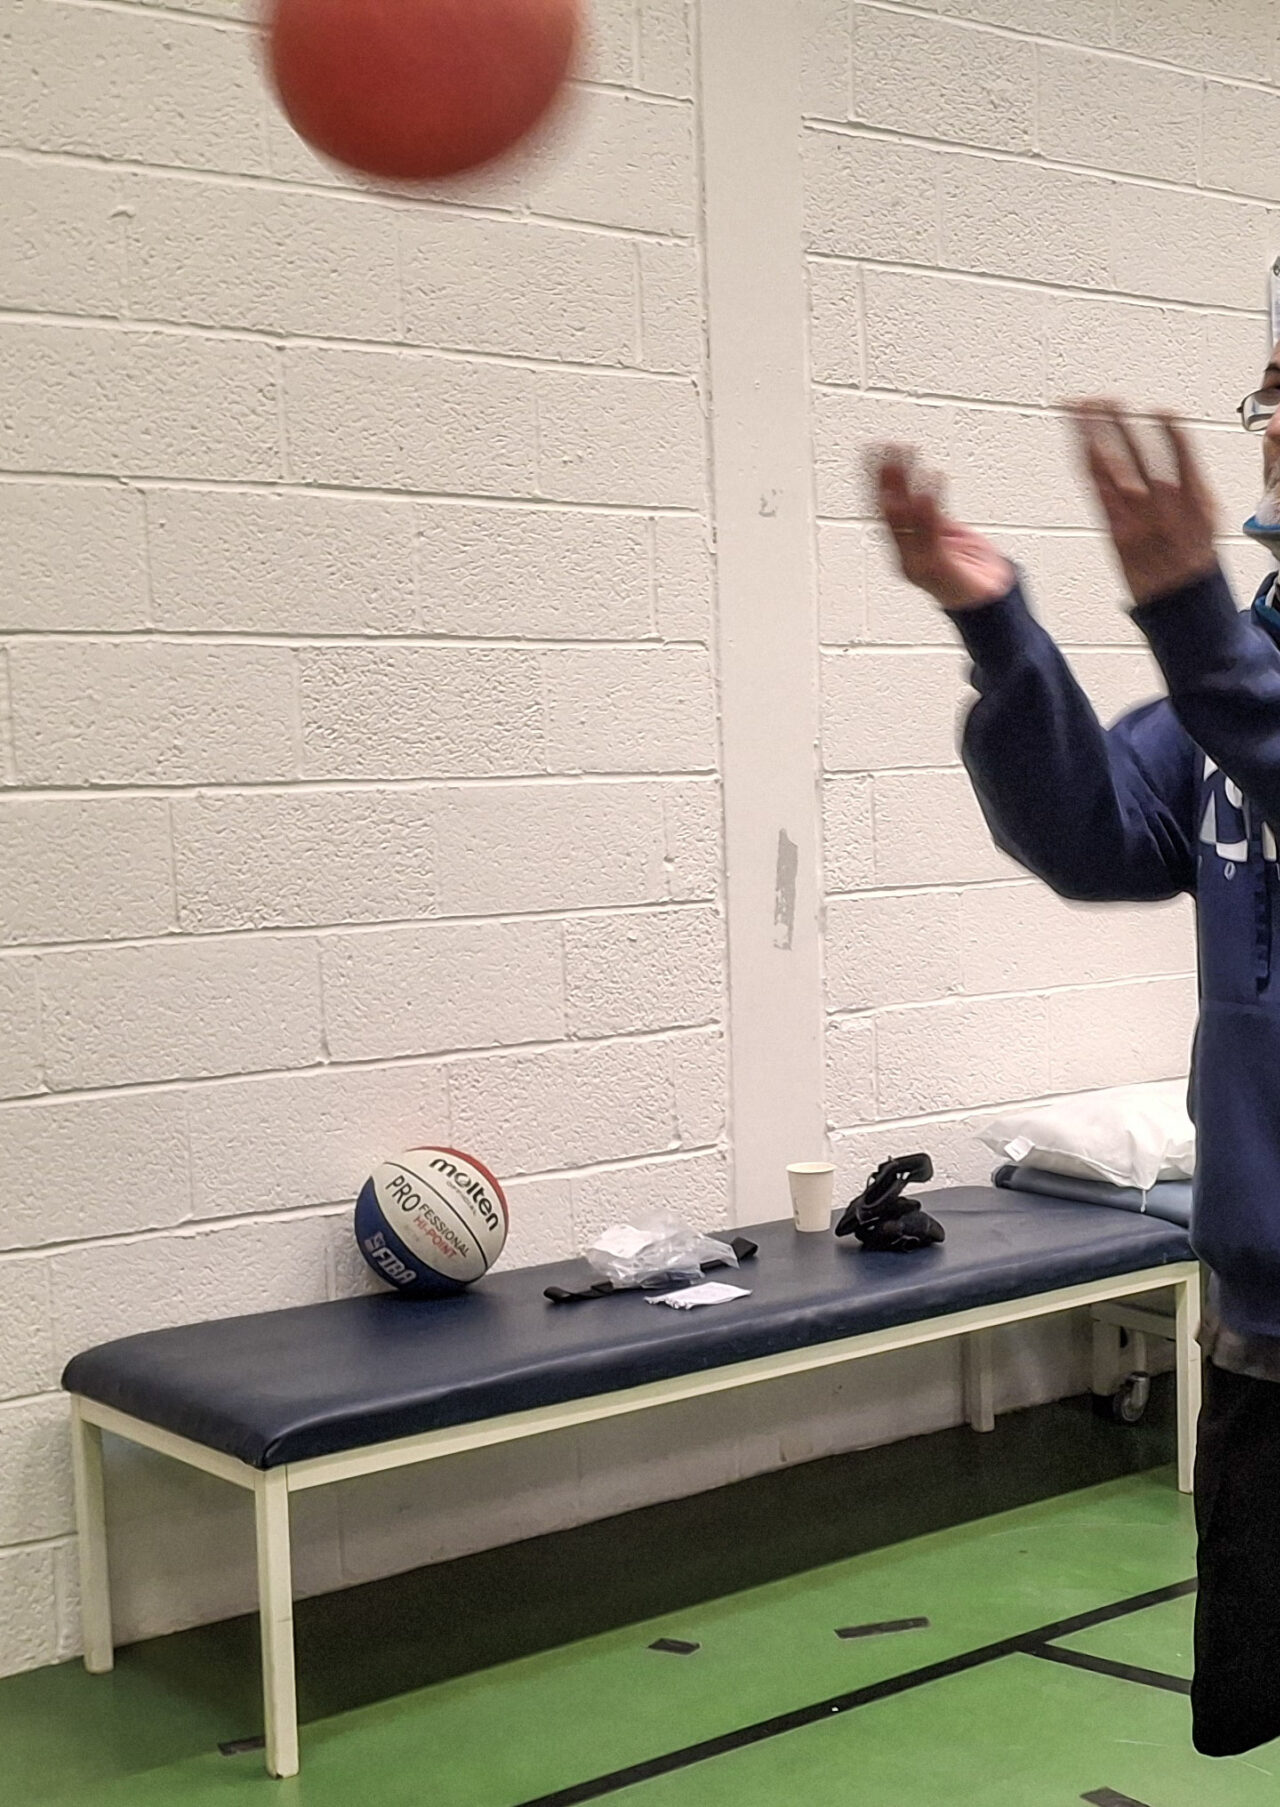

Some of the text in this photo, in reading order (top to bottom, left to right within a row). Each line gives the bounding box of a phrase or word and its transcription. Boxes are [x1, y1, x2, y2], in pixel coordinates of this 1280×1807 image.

[429, 1158, 499, 1232] molten
[413, 1215, 457, 1259] HI-POINT
[371, 1246, 417, 1285] FIBA
